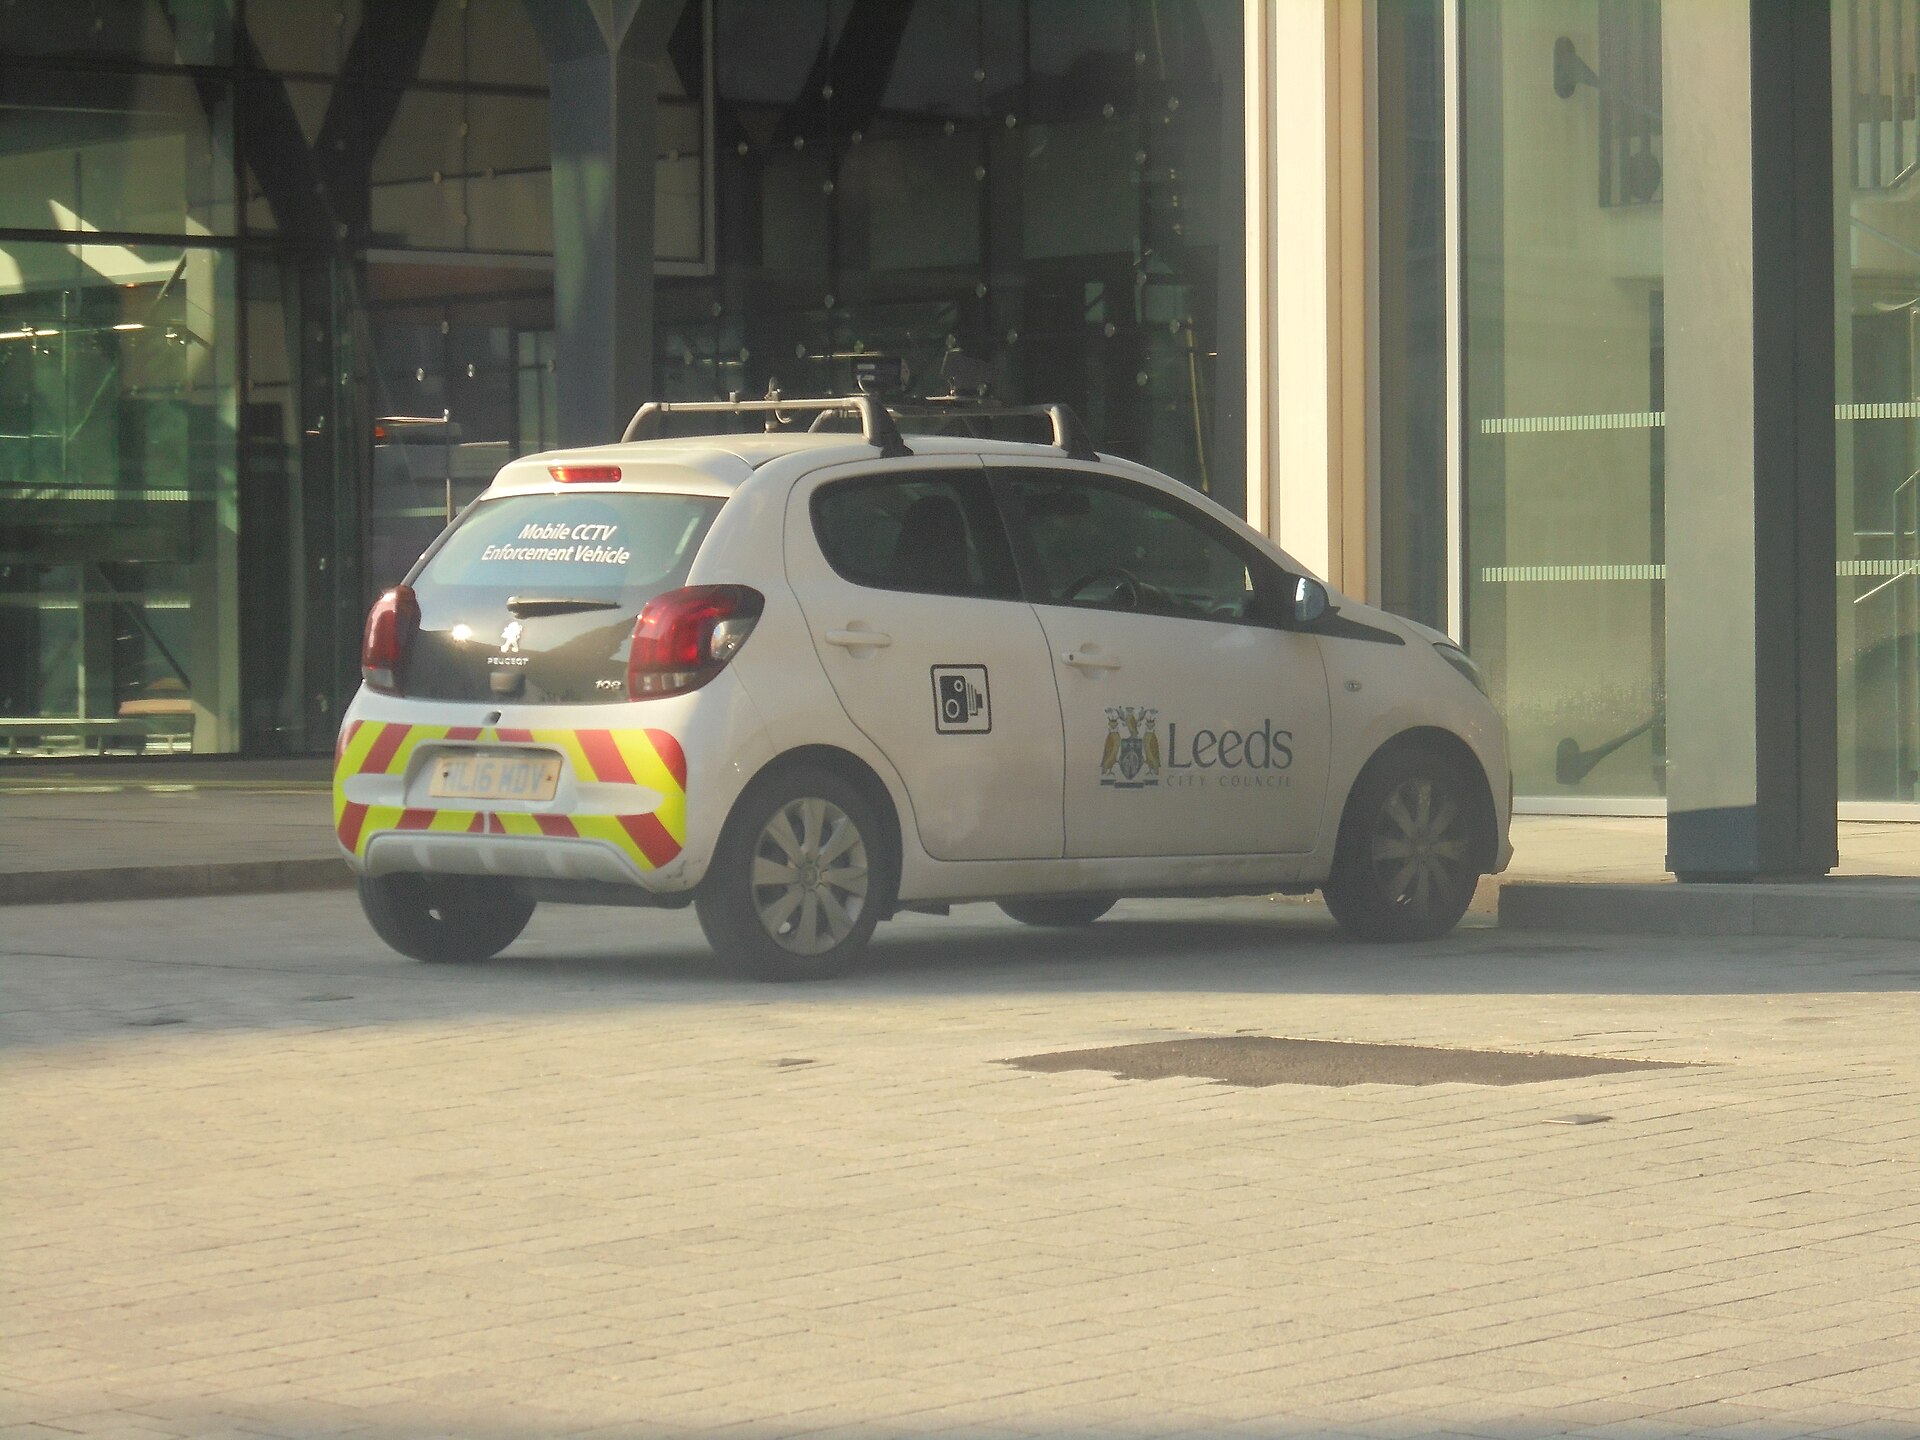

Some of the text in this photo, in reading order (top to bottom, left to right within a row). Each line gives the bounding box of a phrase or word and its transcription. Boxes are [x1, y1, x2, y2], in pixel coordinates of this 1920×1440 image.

[518, 523, 617, 541] Mobile CCTV
[481, 544, 630, 564] Enforcement Vehicle
[595, 680, 622, 690] 108
[1168, 718, 1293, 769] Leeds
[1166, 775, 1291, 787] CITY COUNCIL
